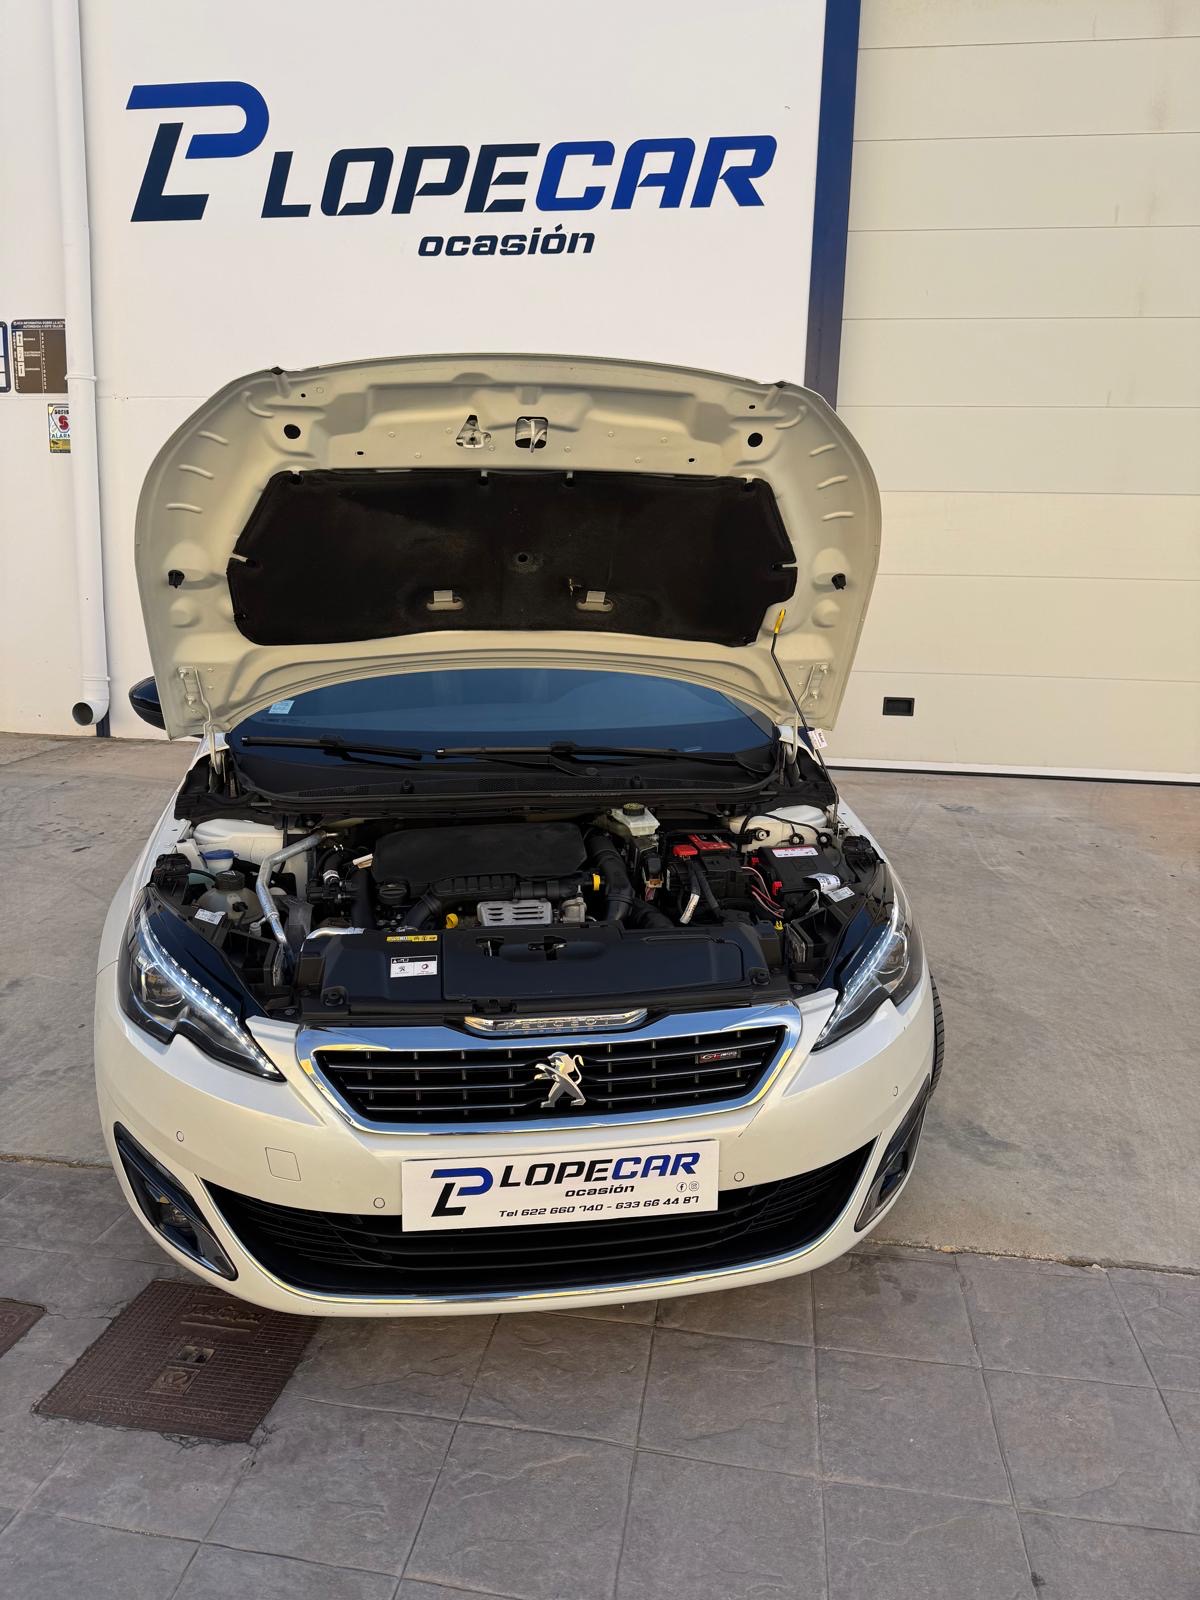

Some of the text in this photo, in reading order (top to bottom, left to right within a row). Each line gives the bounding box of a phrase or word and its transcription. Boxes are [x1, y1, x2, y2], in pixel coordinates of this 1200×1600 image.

[261, 134, 777, 218] LOPECAR
[418, 224, 595, 257] ocasión
[499, 1152, 701, 1188] LOPECAR
[499, 1210, 518, 1218] Tel
[521, 1208, 547, 1216] 622
[550, 1206, 576, 1214] 660
[579, 1204, 604, 1212] 740
[615, 1201, 641, 1210] 633
[643, 1199, 660, 1207] 66
[662, 1197, 679, 1205] 44
[683, 1195, 699, 1204] 87
[565, 1184, 635, 1198] ocasión
